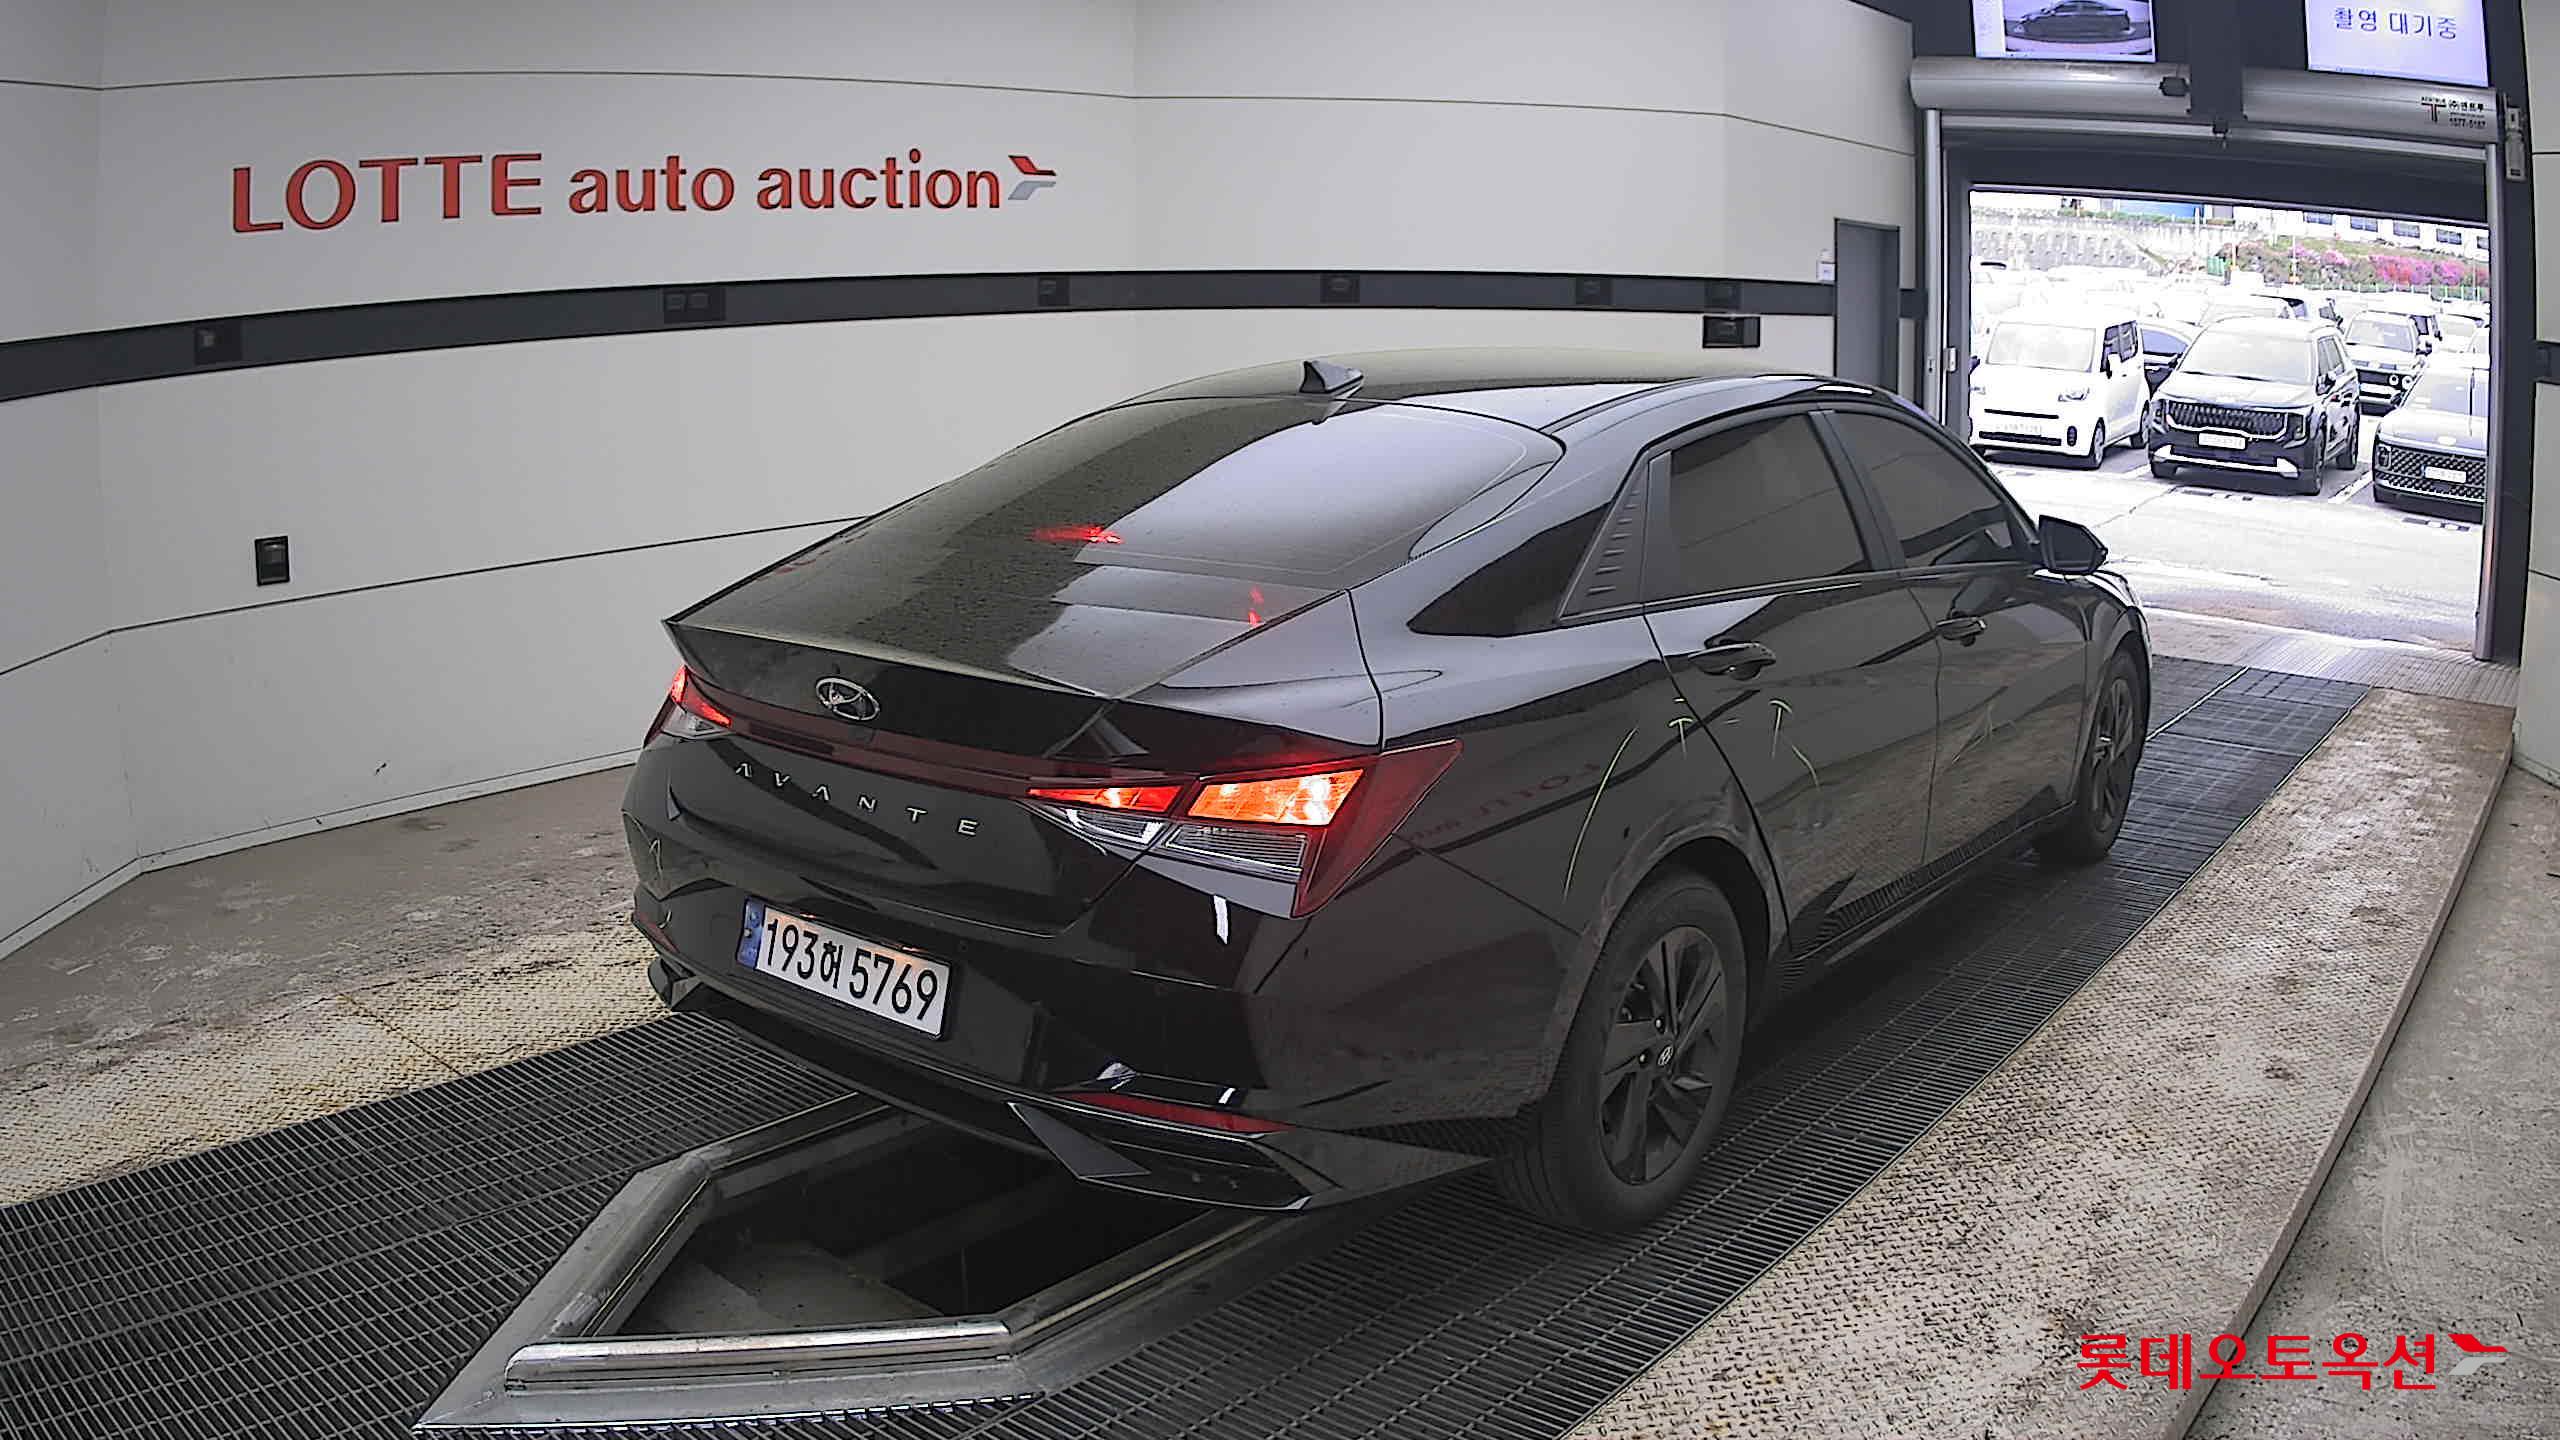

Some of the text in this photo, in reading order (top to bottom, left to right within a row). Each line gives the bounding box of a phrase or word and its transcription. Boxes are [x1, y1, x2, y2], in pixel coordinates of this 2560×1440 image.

[2335, 7, 2457, 40] 촬영 대기중
[232, 148, 1000, 233] LOTTE auto auction
[735, 762, 978, 836] AVANTE
[767, 918, 938, 1021] 193허 5769
